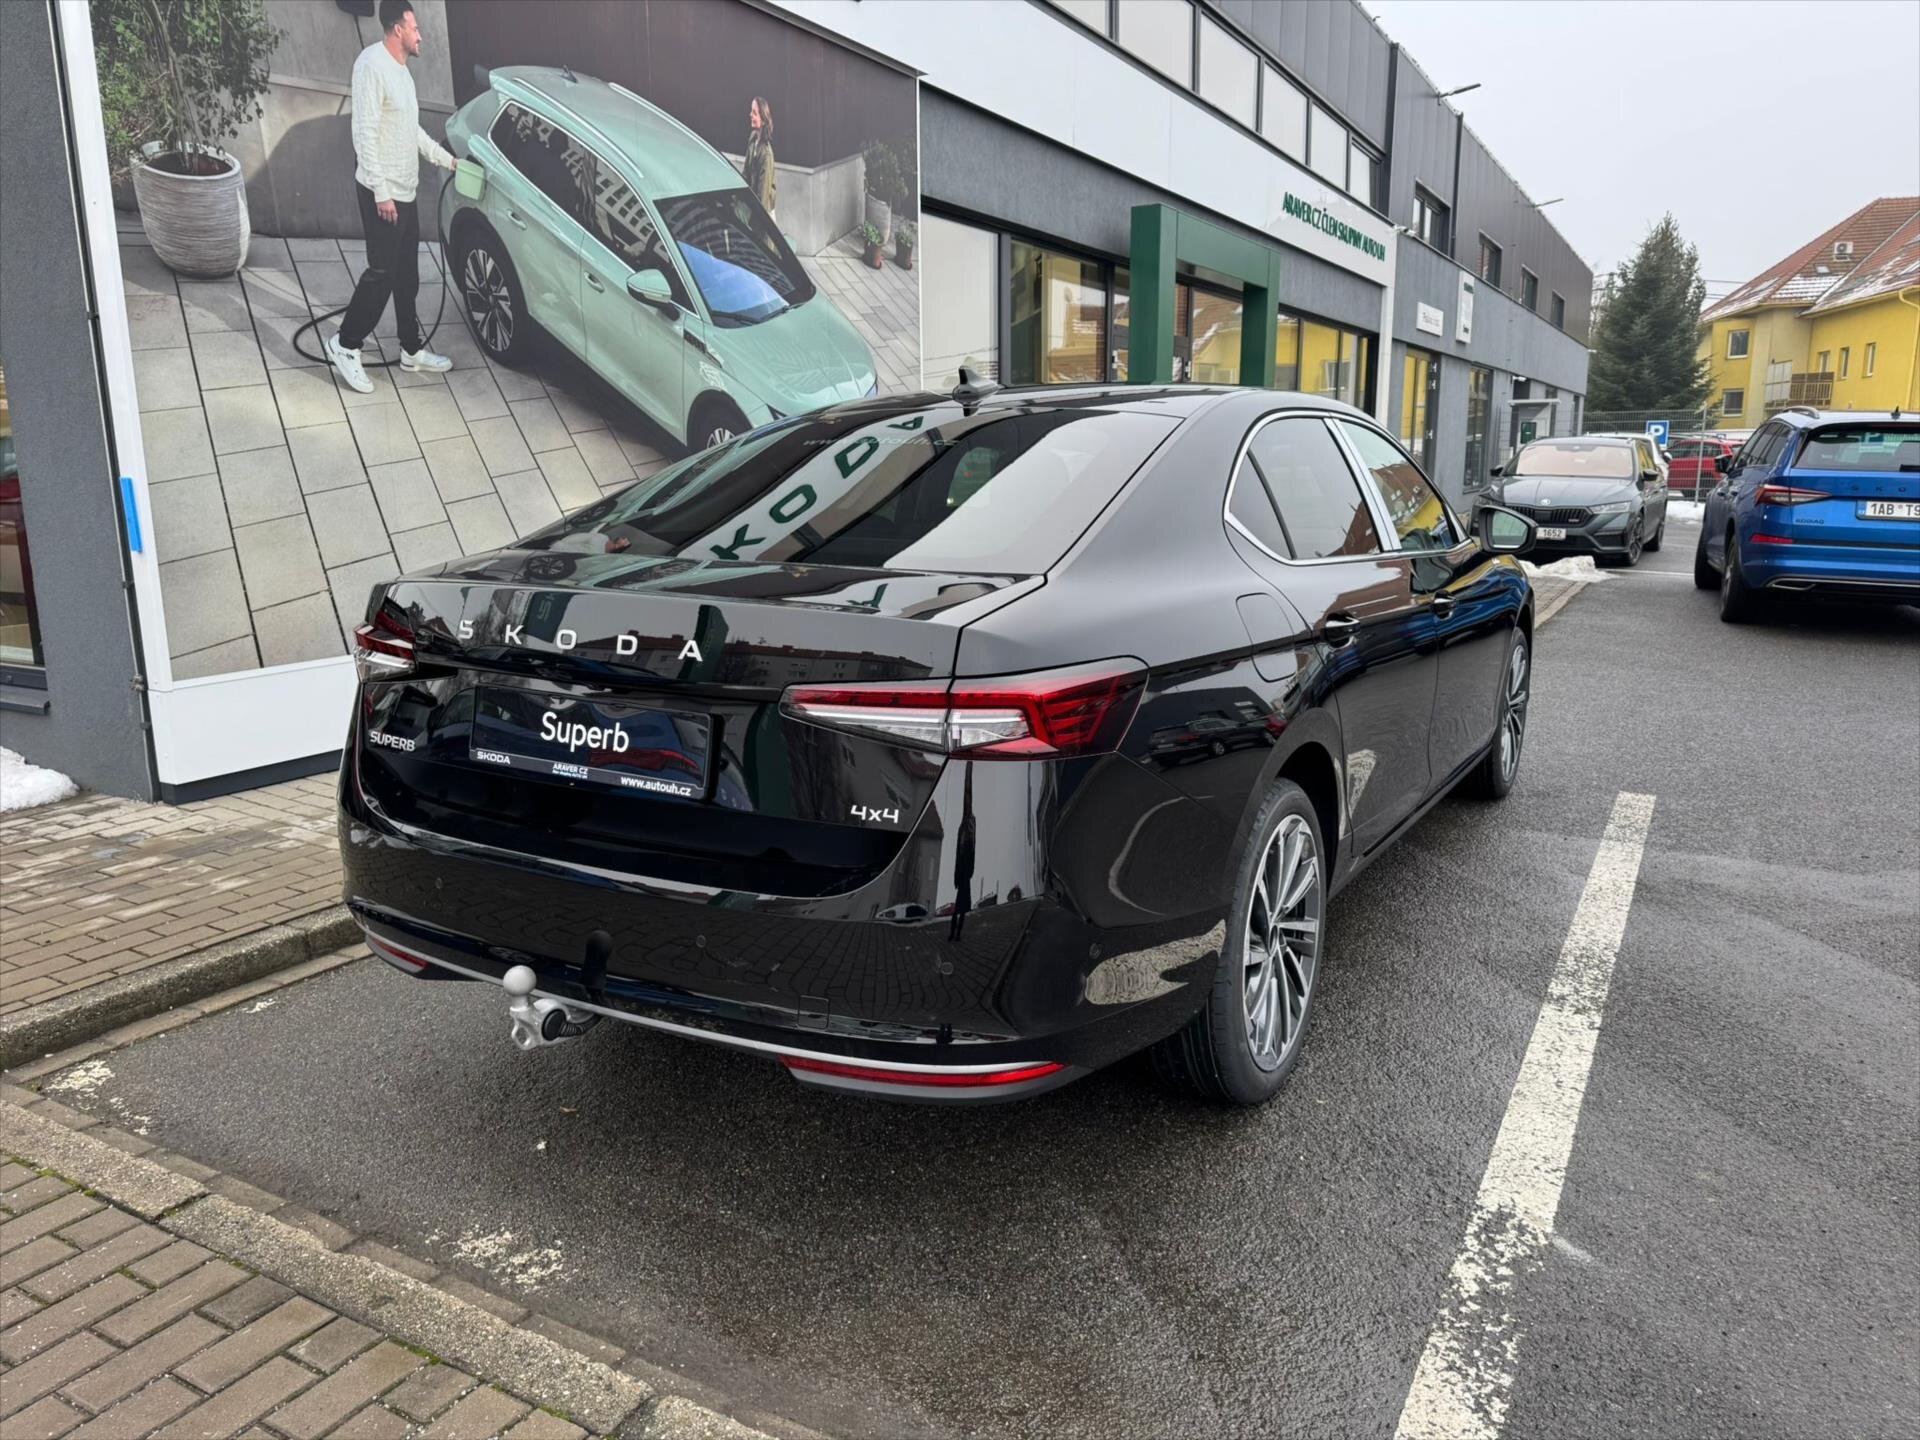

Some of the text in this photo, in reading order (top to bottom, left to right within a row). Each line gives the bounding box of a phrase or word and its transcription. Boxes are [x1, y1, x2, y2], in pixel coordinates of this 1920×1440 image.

[1282, 191, 1312, 225] ARAVER
[1312, 208, 1322, 230] CZ
[1650, 425, 1664, 438] P
[1870, 502, 1894, 516] 1AB
[1542, 529, 1562, 538] 1652
[369, 731, 416, 752] SUPERB
[540, 710, 630, 753] Superb
[552, 762, 578, 773] ARAVER
[578, 767, 589, 775] CZ
[620, 775, 691, 797] www.autouh.cz
[850, 804, 900, 824] 4x4
